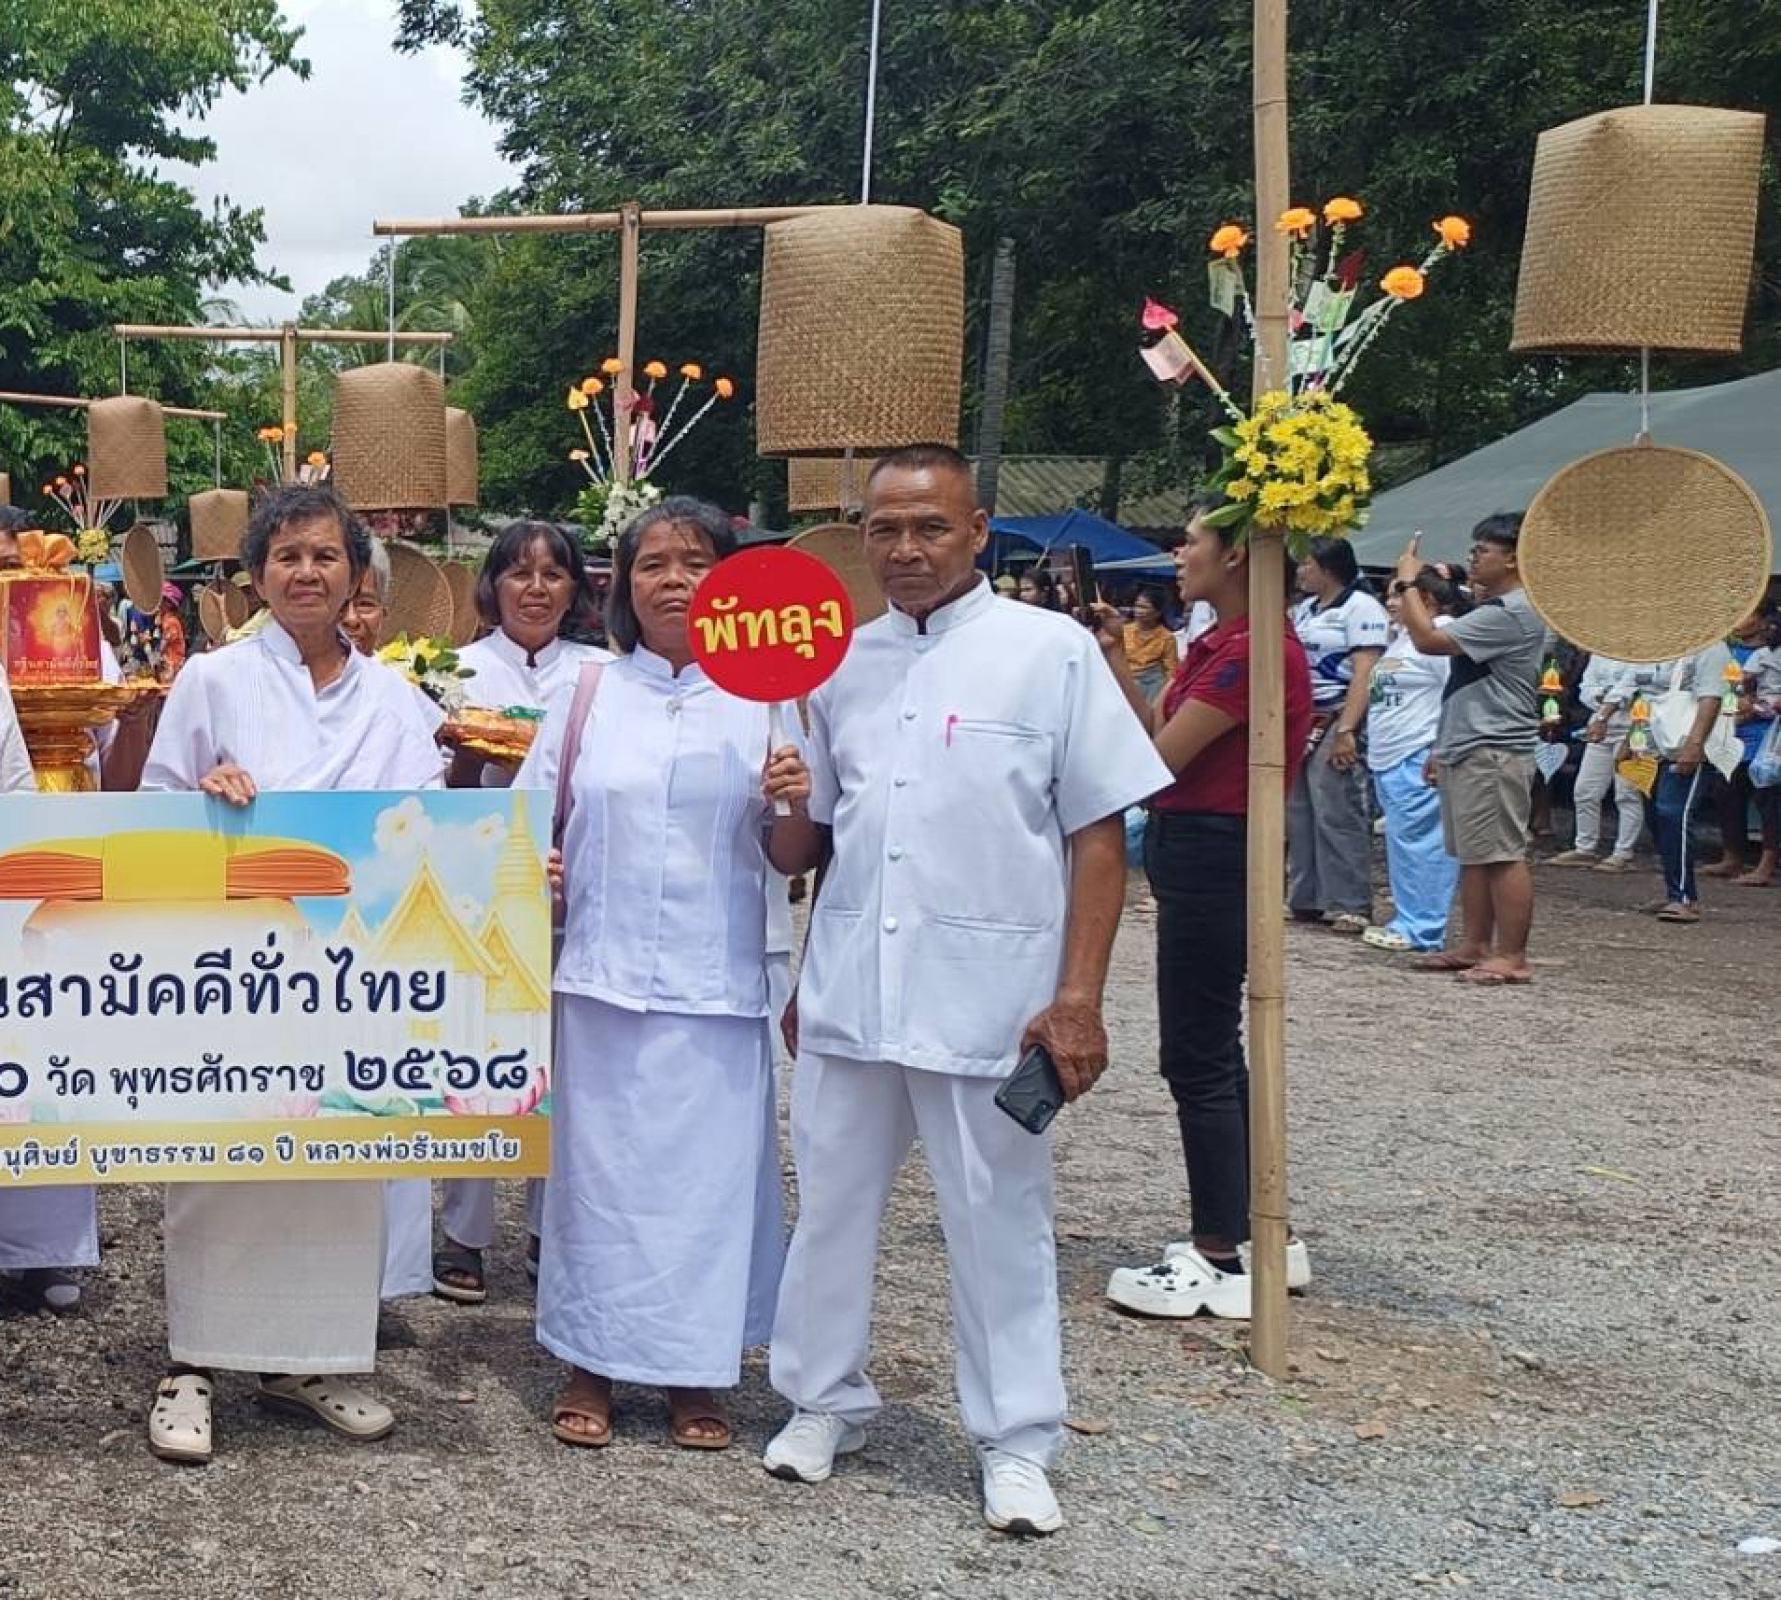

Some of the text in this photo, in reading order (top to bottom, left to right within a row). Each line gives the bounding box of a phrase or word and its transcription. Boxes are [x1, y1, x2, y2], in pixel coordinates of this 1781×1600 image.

[694, 595, 844, 660] พัทลุง
[46, 1054, 96, 1097] วัด
[109, 1052, 325, 1109] พุทธศักราช
[343, 1047, 529, 1091] ๒๕๖๘
[90, 1144, 216, 1174] บูชาธรรม
[226, 1145, 264, 1163] ๘๑
[275, 1135, 295, 1162] ปี
[305, 1132, 520, 1161] หลวงพ่อธัมมชโย
